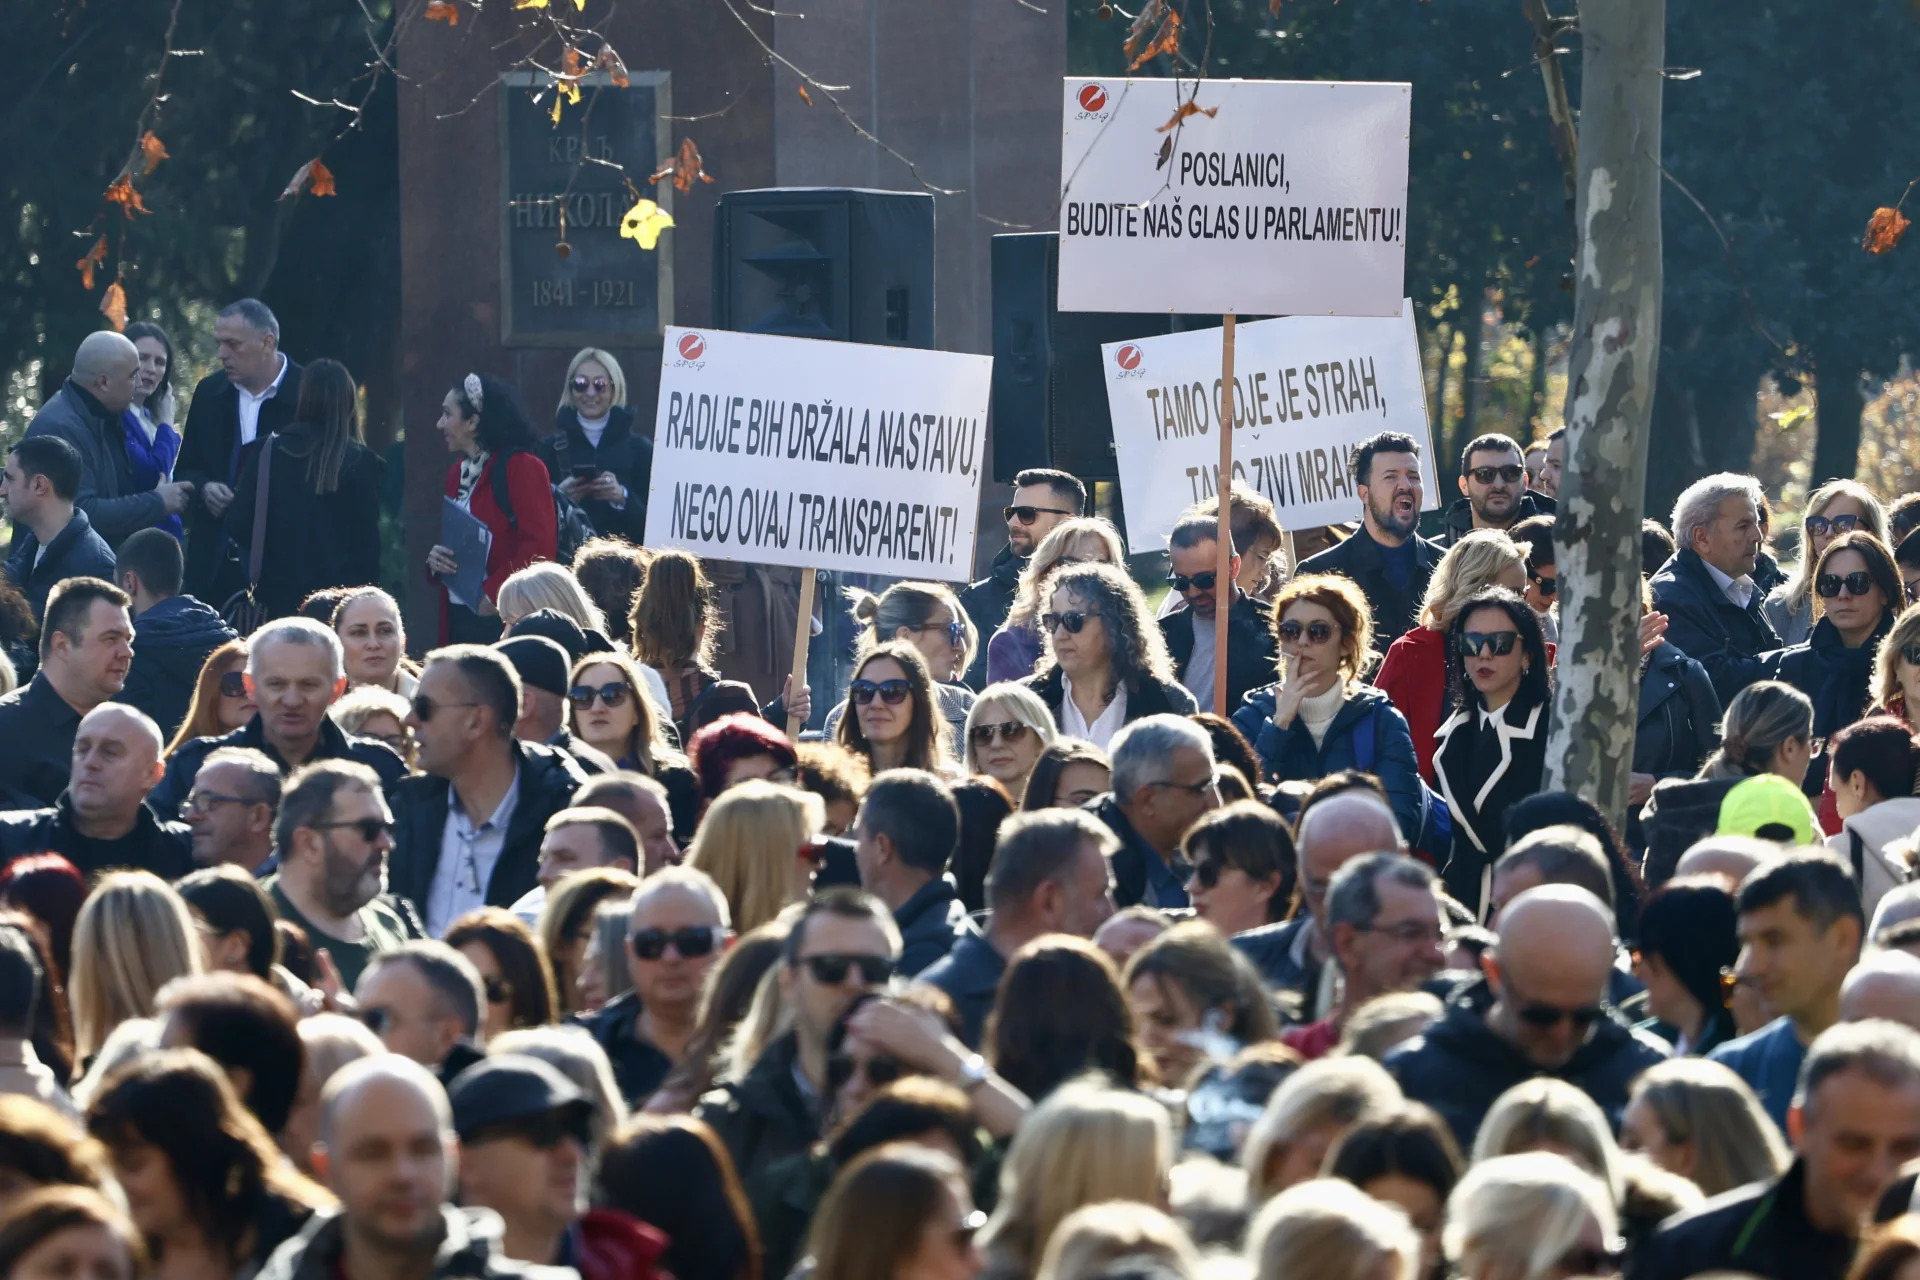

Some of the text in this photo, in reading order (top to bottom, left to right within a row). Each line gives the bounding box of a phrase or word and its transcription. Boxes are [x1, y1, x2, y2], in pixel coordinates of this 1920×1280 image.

[1180, 151, 1290, 194] POSLANICI,
[1067, 196, 1401, 242] BUDITE NAŠ GLAS U PARLAMENTU!
[1146, 381, 1209, 441] TAMO
[1276, 367, 1305, 423] JE
[1304, 356, 1387, 418] STRAH,
[665, 391, 977, 488] RADIJE BIH DRŽALA NASTAVU,
[1186, 459, 1245, 505] TA
[1251, 434, 1297, 509] ŽIVI
[670, 481, 959, 565] NEGO OVAJ TRANSPARENT!
